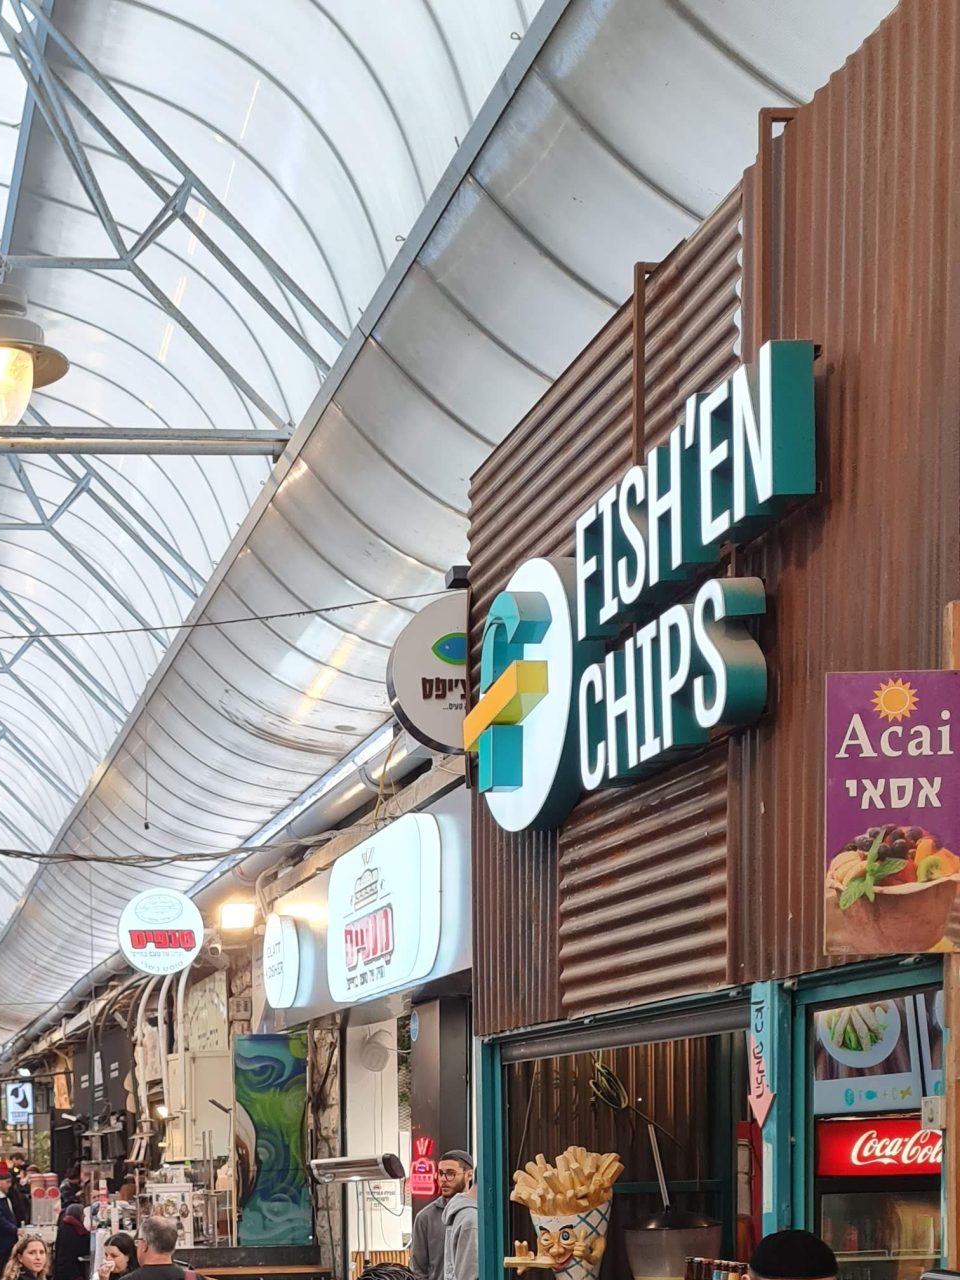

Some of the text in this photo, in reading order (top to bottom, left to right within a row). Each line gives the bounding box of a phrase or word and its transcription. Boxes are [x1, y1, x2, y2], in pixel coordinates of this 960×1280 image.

[575, 339, 775, 642] FISH'EN
[578, 577, 728, 792] CHIPS
[835, 709, 955, 759] Acai
[845, 776, 942, 810] אסאי
